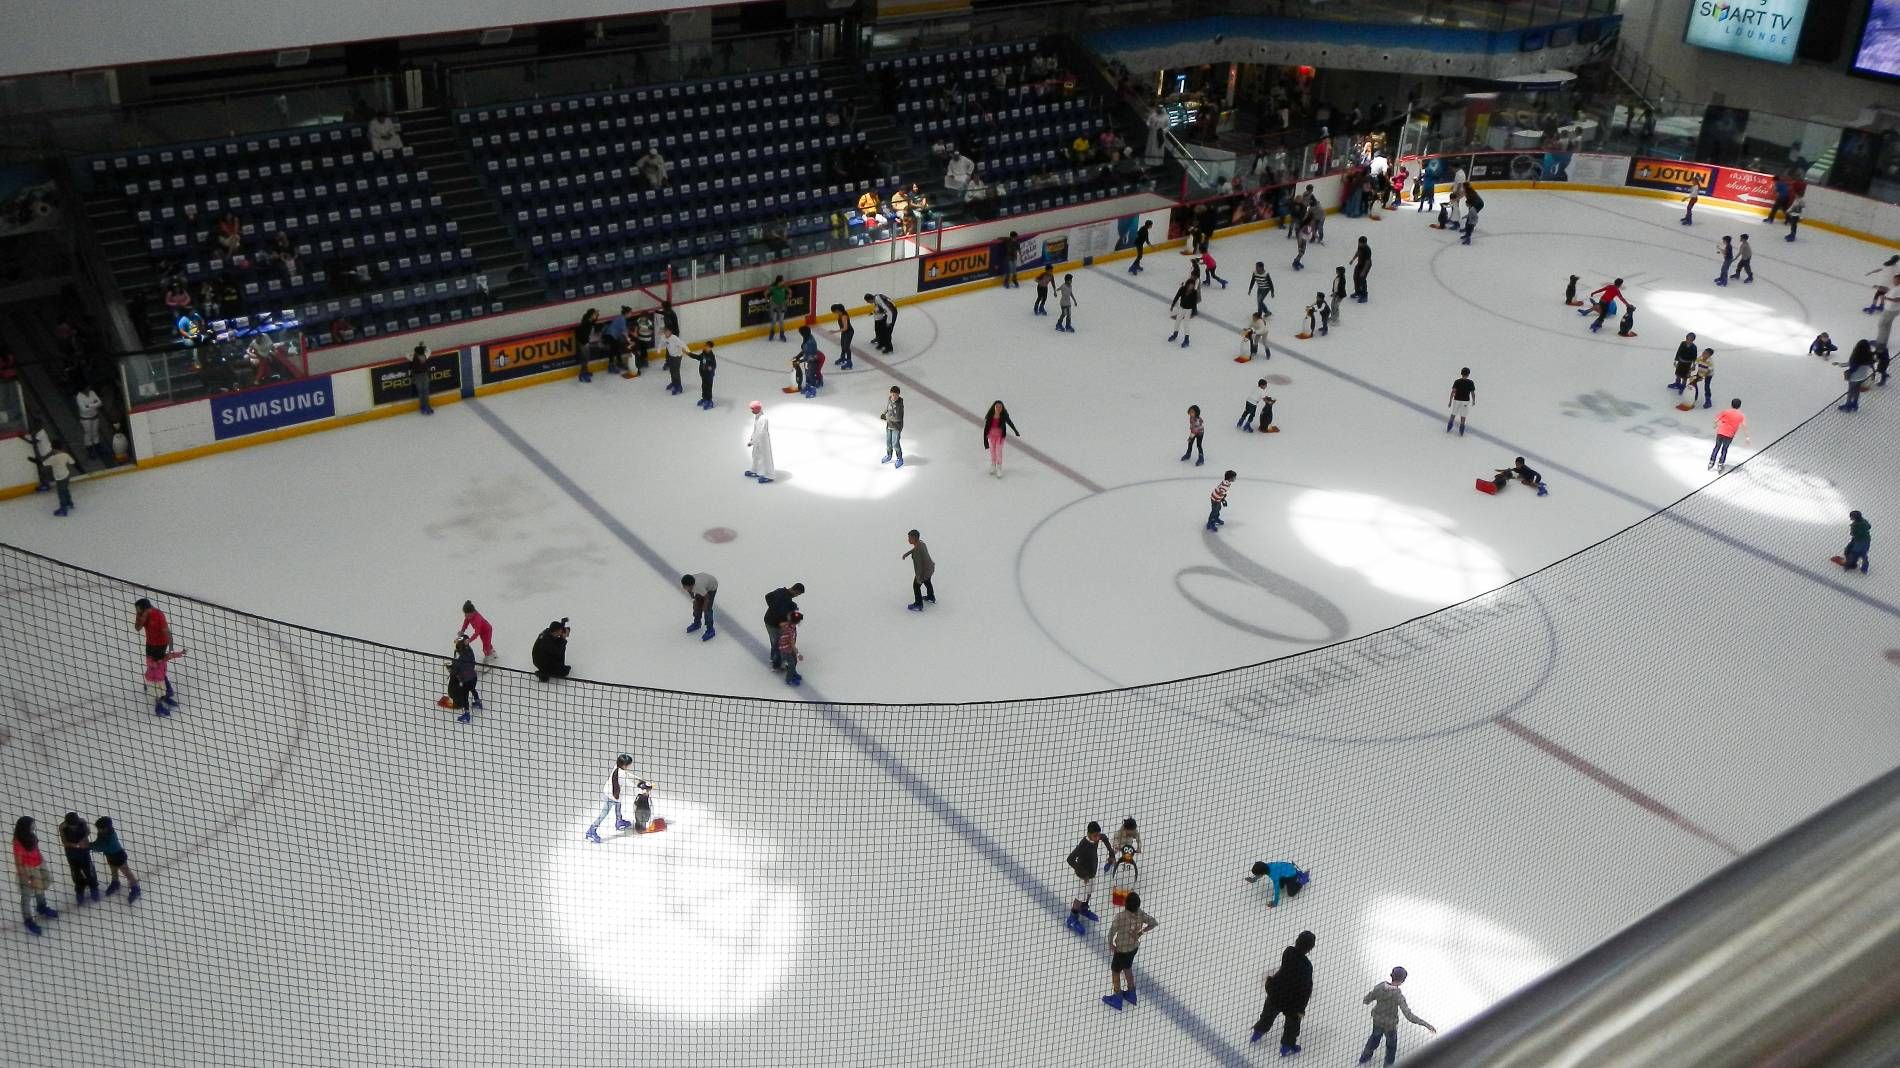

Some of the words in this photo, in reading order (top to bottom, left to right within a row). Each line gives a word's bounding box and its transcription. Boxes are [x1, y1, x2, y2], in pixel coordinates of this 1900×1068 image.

[1700, 1, 1767, 26] SMART
[1771, 13, 1793, 31] TV
[1725, 26, 1789, 45] LOUNGE
[1654, 166, 1707, 184] JOTUN
[942, 252, 988, 275] JOTUN
[513, 337, 573, 365] JOTUN
[382, 369, 453, 392] PROIDE
[221, 390, 326, 425] SAMSUNG
